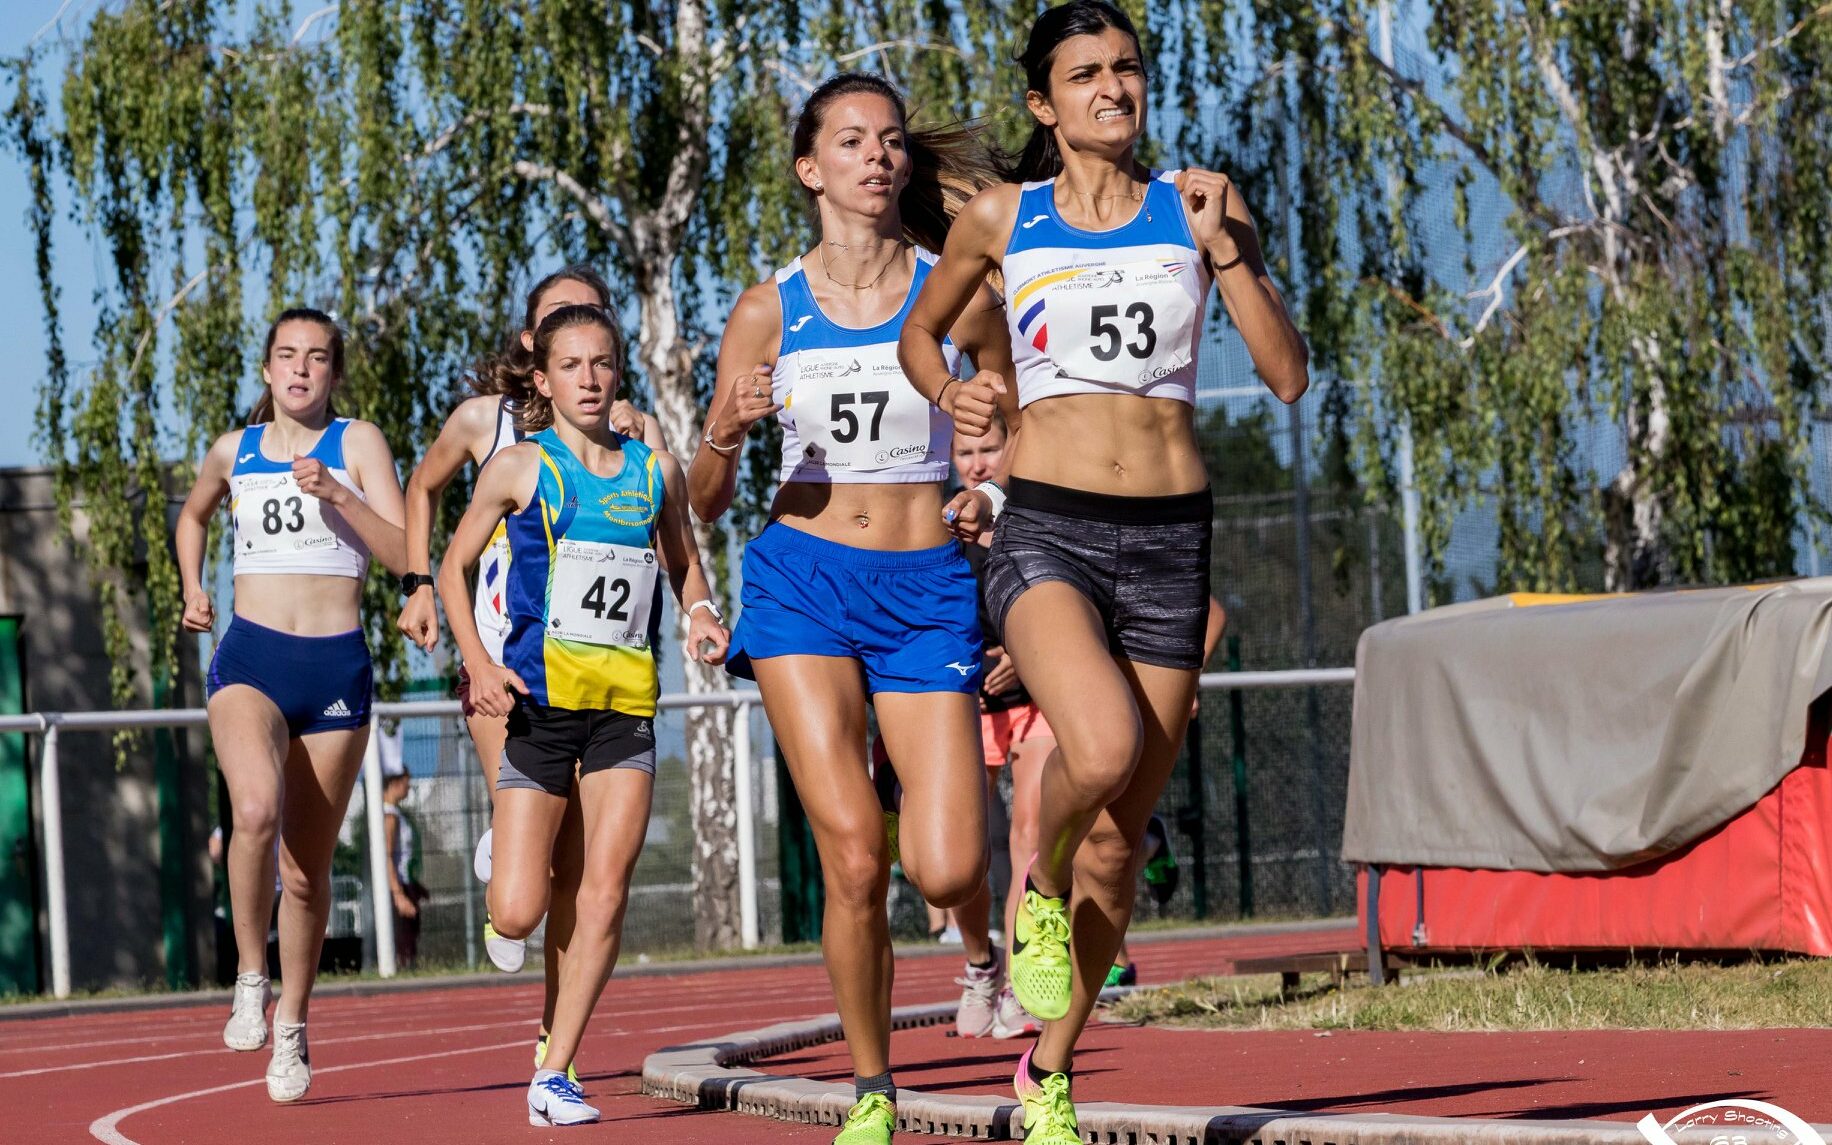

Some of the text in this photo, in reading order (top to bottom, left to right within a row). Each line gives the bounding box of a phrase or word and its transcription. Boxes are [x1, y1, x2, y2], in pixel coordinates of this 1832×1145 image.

[1037, 264, 1074, 278] ATHLETISME
[1089, 301, 1157, 362] 53
[830, 390, 890, 444] 57
[889, 444, 926, 458] Casino
[262, 496, 305, 535] 83
[580, 575, 631, 622] 42
[323, 709, 351, 717] adidas
